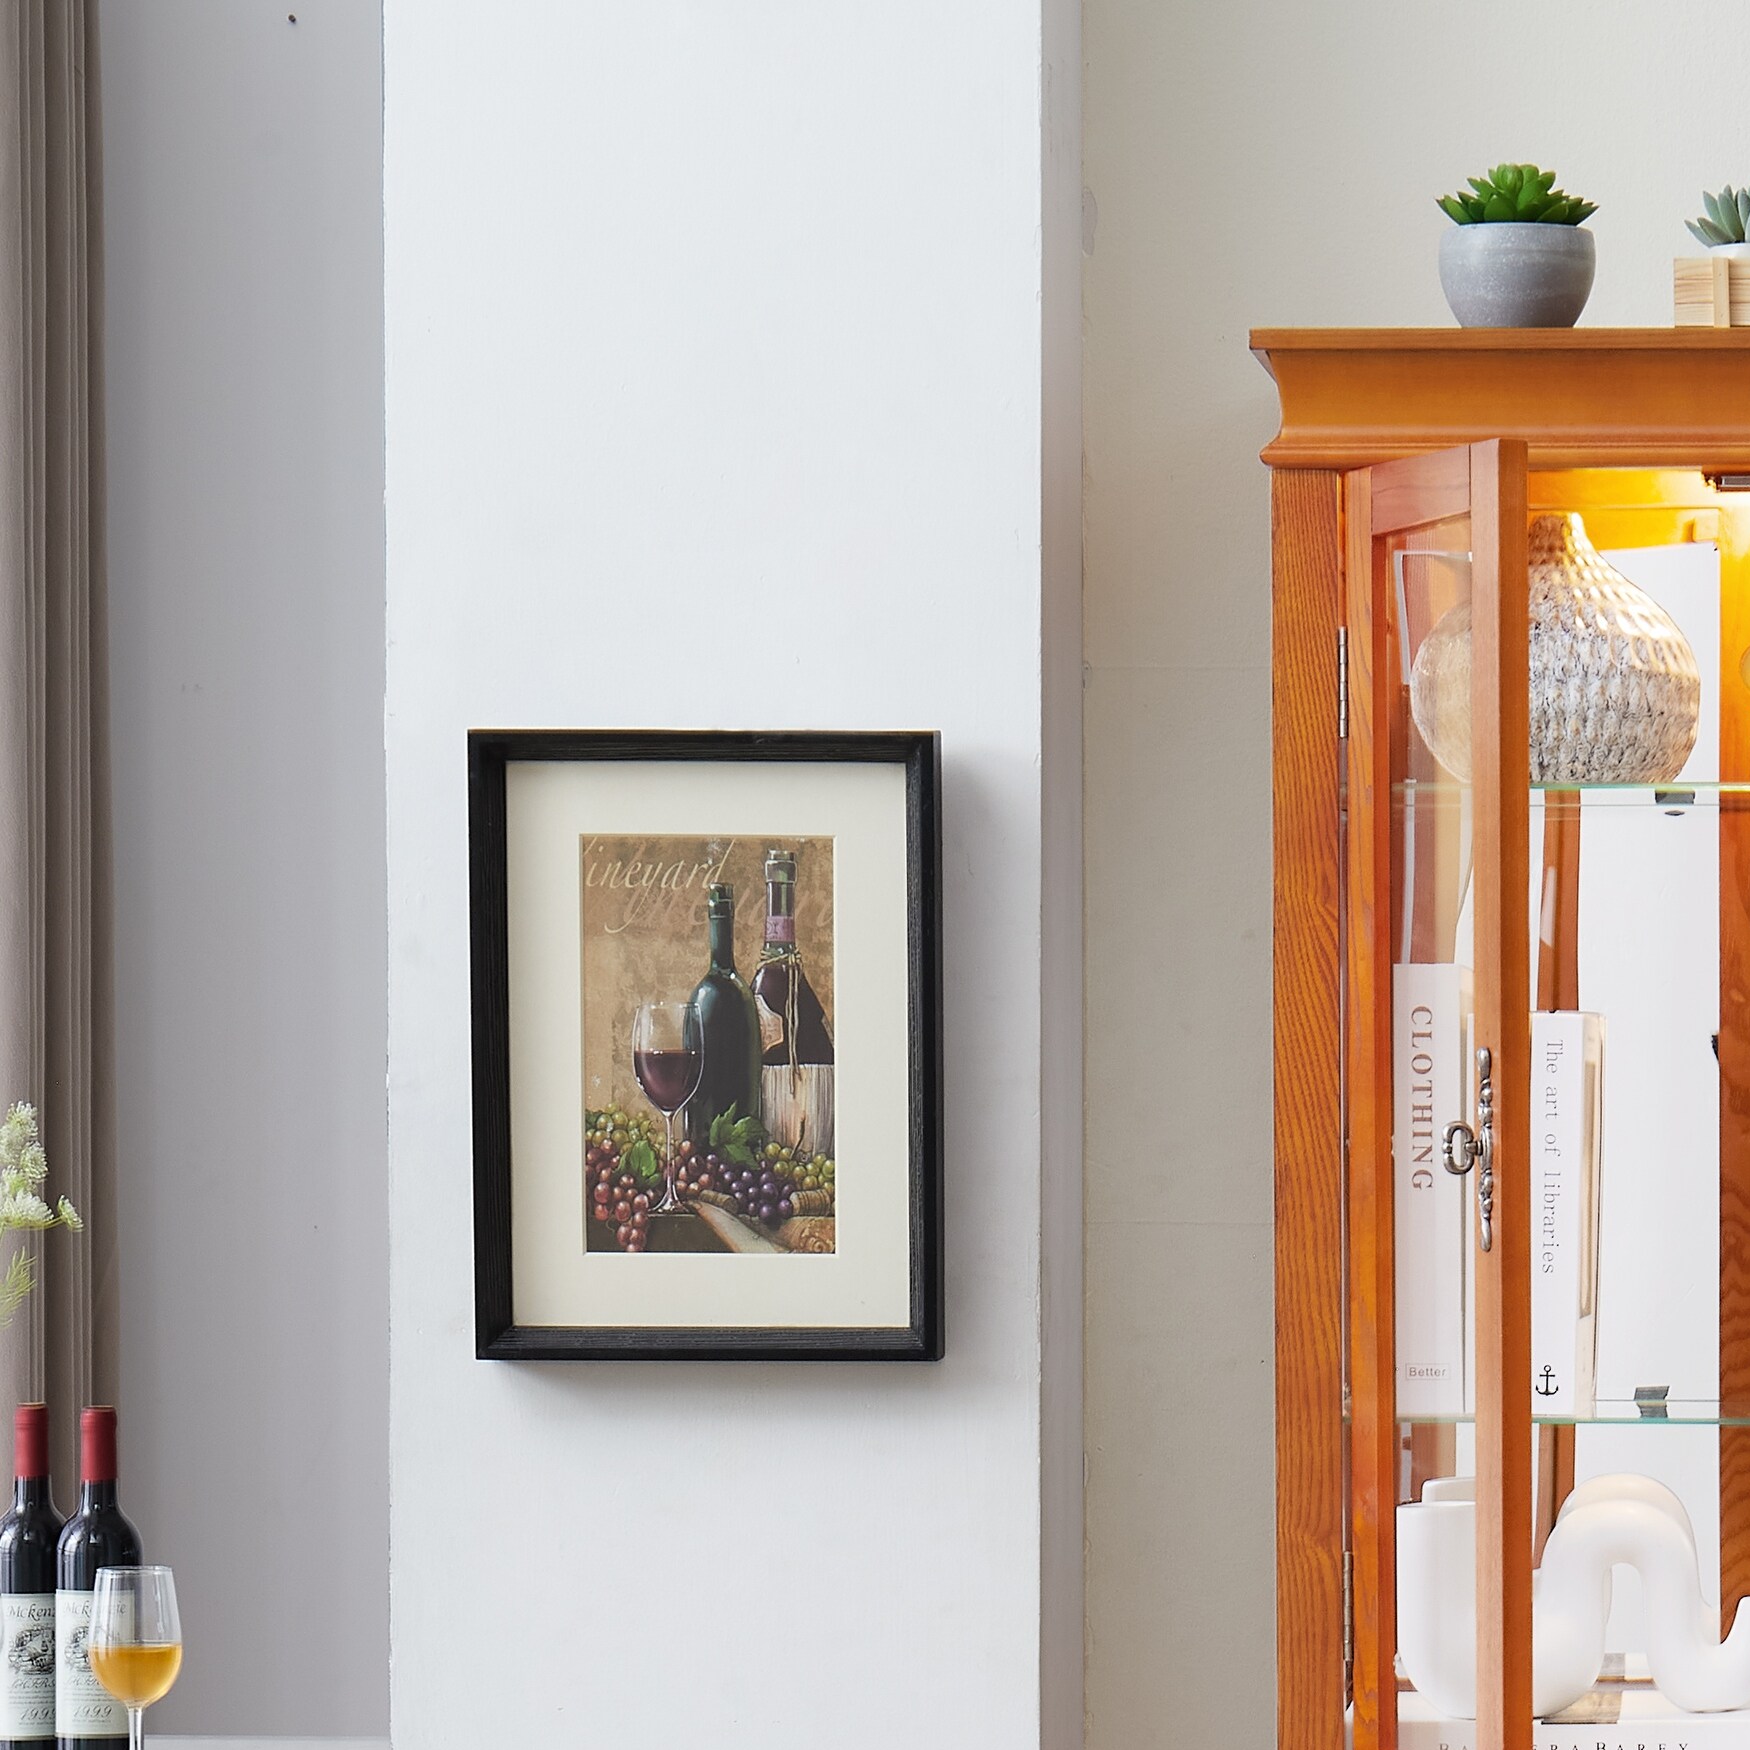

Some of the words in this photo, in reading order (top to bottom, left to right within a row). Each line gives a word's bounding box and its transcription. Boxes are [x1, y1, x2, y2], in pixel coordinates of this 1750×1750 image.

[583, 837, 736, 933] ineyard
[1546, 1039, 1564, 1075] The
[1410, 1005, 1433, 1190] CLOTHING
[1544, 1086, 1562, 1120] art
[1545, 1132, 1562, 1158] of
[1540, 1171, 1561, 1275] libraries
[1408, 1365, 1447, 1378] Better
[73, 1705, 112, 1718] 1999
